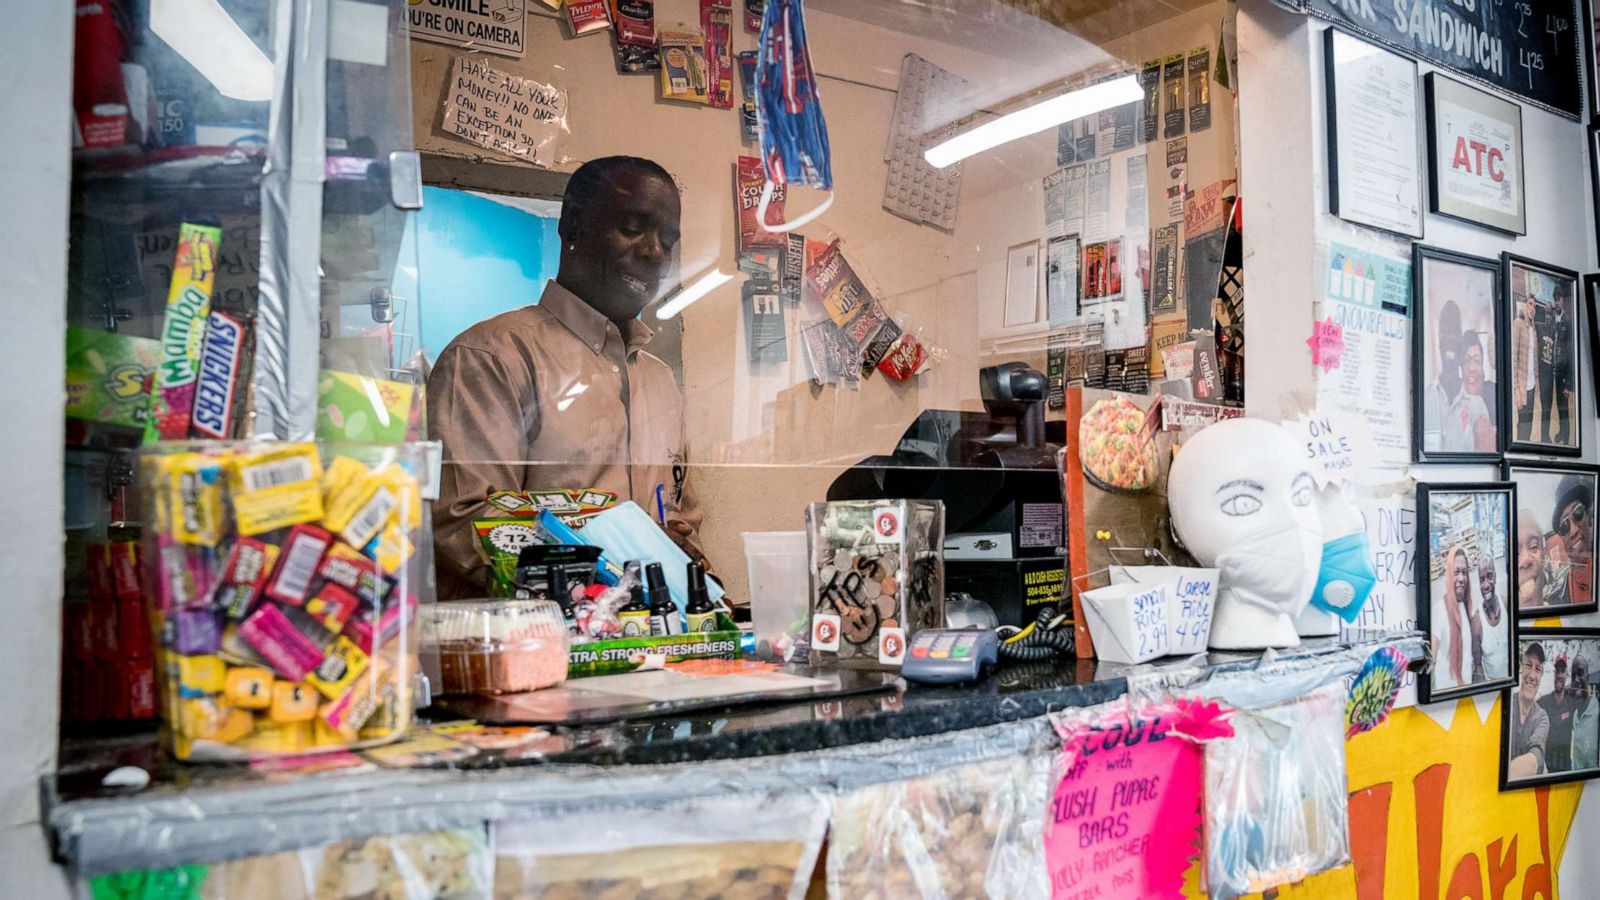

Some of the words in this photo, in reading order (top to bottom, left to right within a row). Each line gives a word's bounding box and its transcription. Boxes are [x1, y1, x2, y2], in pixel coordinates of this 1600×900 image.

[569, 3, 603, 17] TYLENOL
[402, 9, 441, 31] OU'RE
[445, 17, 464, 35] ON
[467, 21, 521, 47] CAMERA
[1393, 0, 1503, 76] SANDWICH
[460, 58, 498, 84] HAVE
[500, 77, 523, 96] ALL
[529, 87, 559, 109] YOUR
[456, 94, 477, 112] CAN
[483, 106, 499, 121] BE
[506, 118, 523, 129] AN
[458, 78, 510, 108] MONEY!!
[513, 100, 529, 116] NO
[533, 108, 556, 124] ONE
[454, 122, 488, 144] DON'T
[457, 109, 516, 141] EXCEPTION
[1452, 136, 1505, 183] ATC
[742, 183, 784, 199] COUH
[744, 191, 784, 210] DRPS
[161, 286, 210, 387] Mamba
[1156, 333, 1177, 349] KEEP
[195, 316, 237, 432] SNICKERS
[1309, 417, 1332, 437] ON
[1307, 436, 1352, 458] SALE
[505, 533, 532, 543] 72
[1378, 508, 1415, 547] ONE
[602, 646, 653, 663] STRONG
[658, 640, 735, 657] FRESHENERS
[1139, 625, 1168, 657] 2.99
[1107, 751, 1133, 771] with
[1054, 787, 1098, 824] LUSH
[1079, 811, 1129, 849] BARS
[1093, 834, 1151, 873] RANCHER
